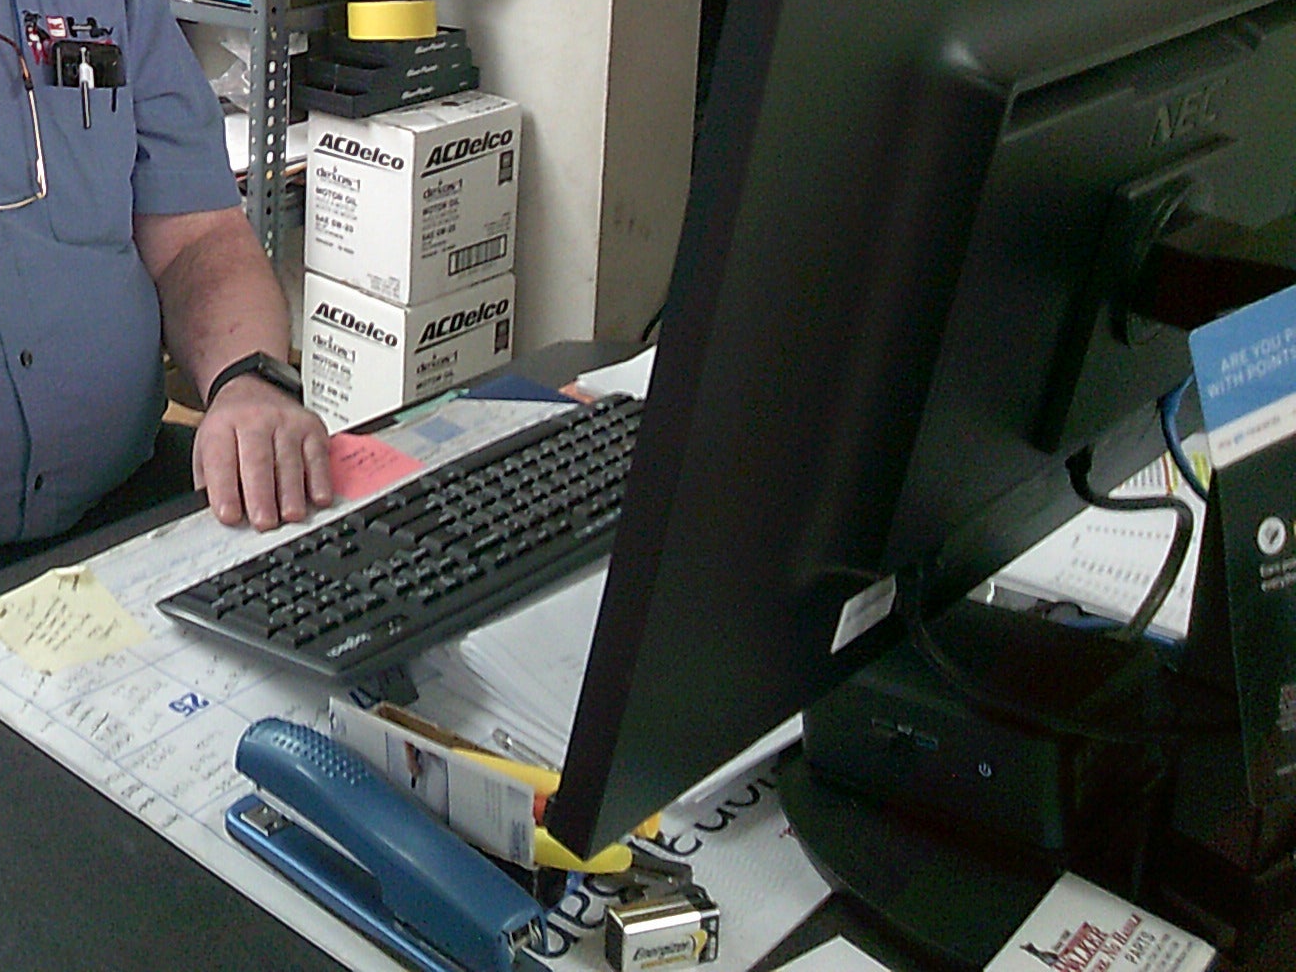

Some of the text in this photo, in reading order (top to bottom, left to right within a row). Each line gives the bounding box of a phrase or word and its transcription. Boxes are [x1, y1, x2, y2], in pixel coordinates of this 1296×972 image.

[318, 133, 404, 170] ACDelco
[425, 129, 513, 169] ACDelco
[315, 302, 398, 347] ACDelco
[419, 298, 510, 345] ACDelco
[1220, 348, 1249, 373] ARE
[1252, 333, 1281, 359] YOU
[1207, 364, 1245, 400] WITH
